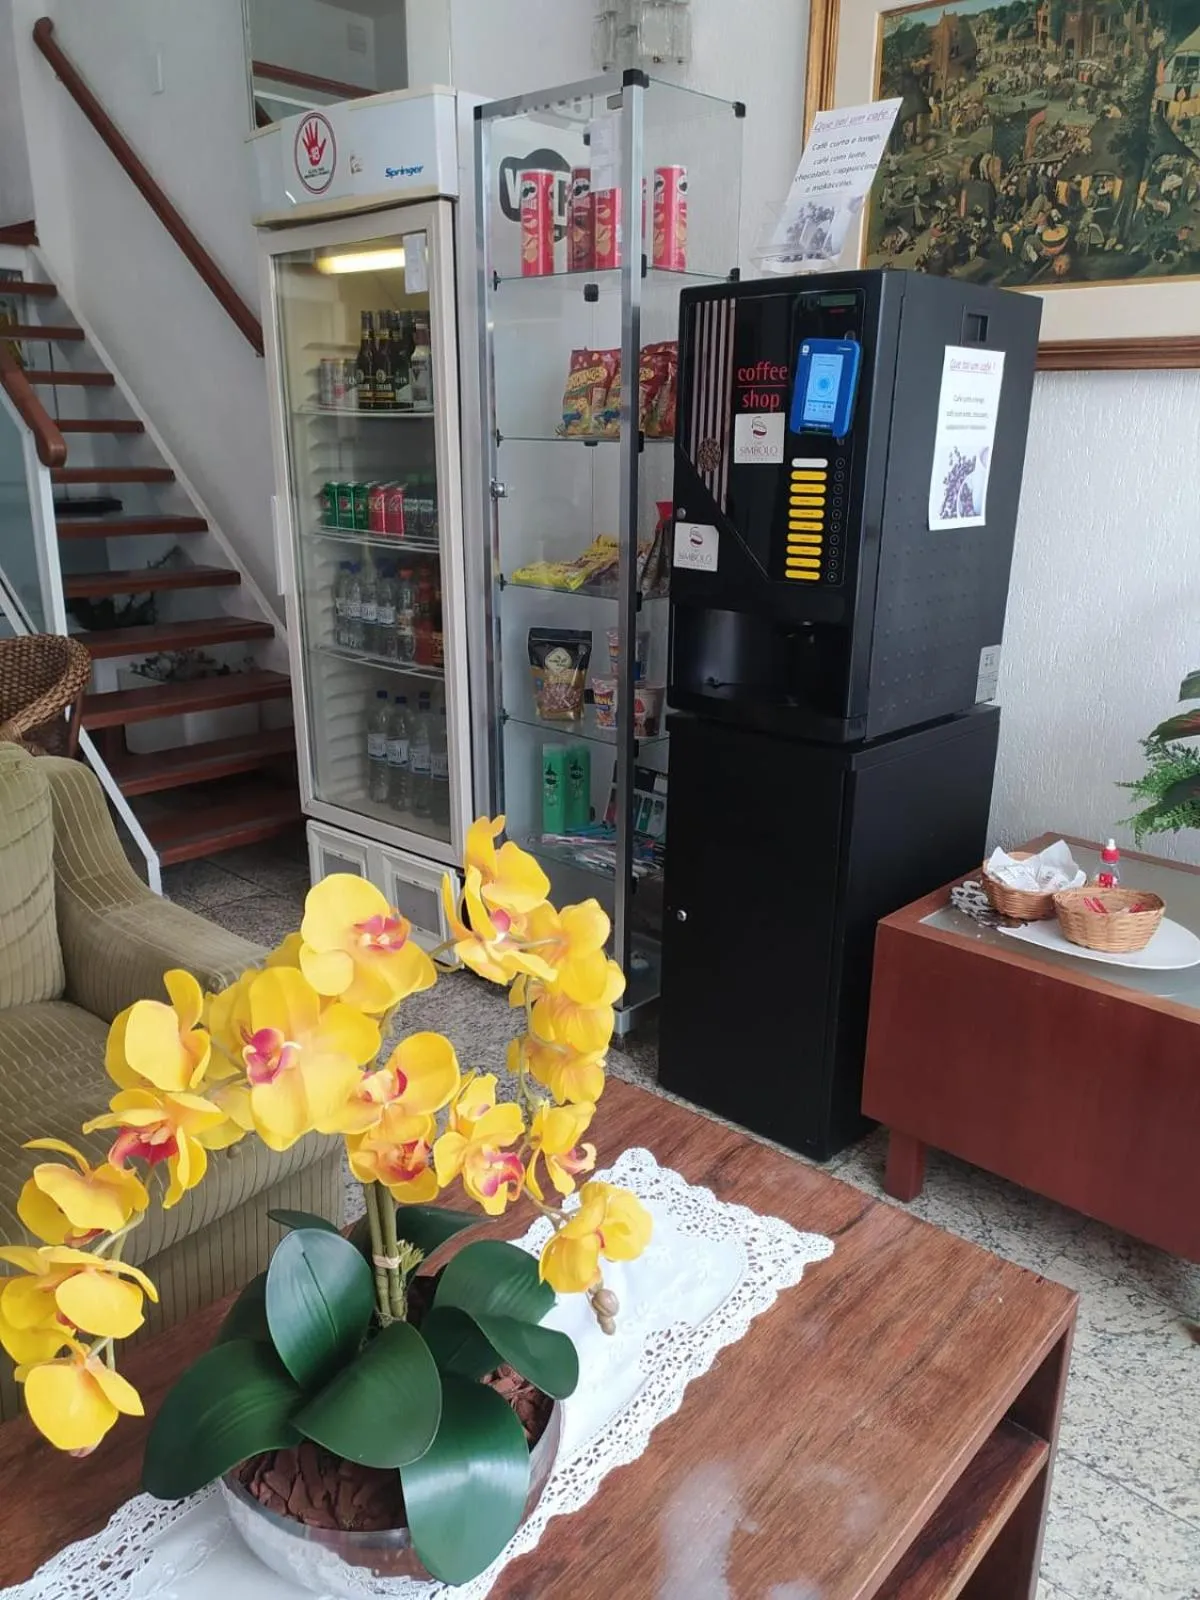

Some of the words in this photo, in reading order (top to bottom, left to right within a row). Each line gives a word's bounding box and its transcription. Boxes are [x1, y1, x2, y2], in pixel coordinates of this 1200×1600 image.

[812, 141, 829, 151] Café
[830, 138, 850, 149] curto
[813, 155, 829, 166] café
[830, 154, 847, 162] com
[384, 164, 424, 179] Springer
[737, 360, 788, 382] coffee
[742, 388, 781, 413] shop
